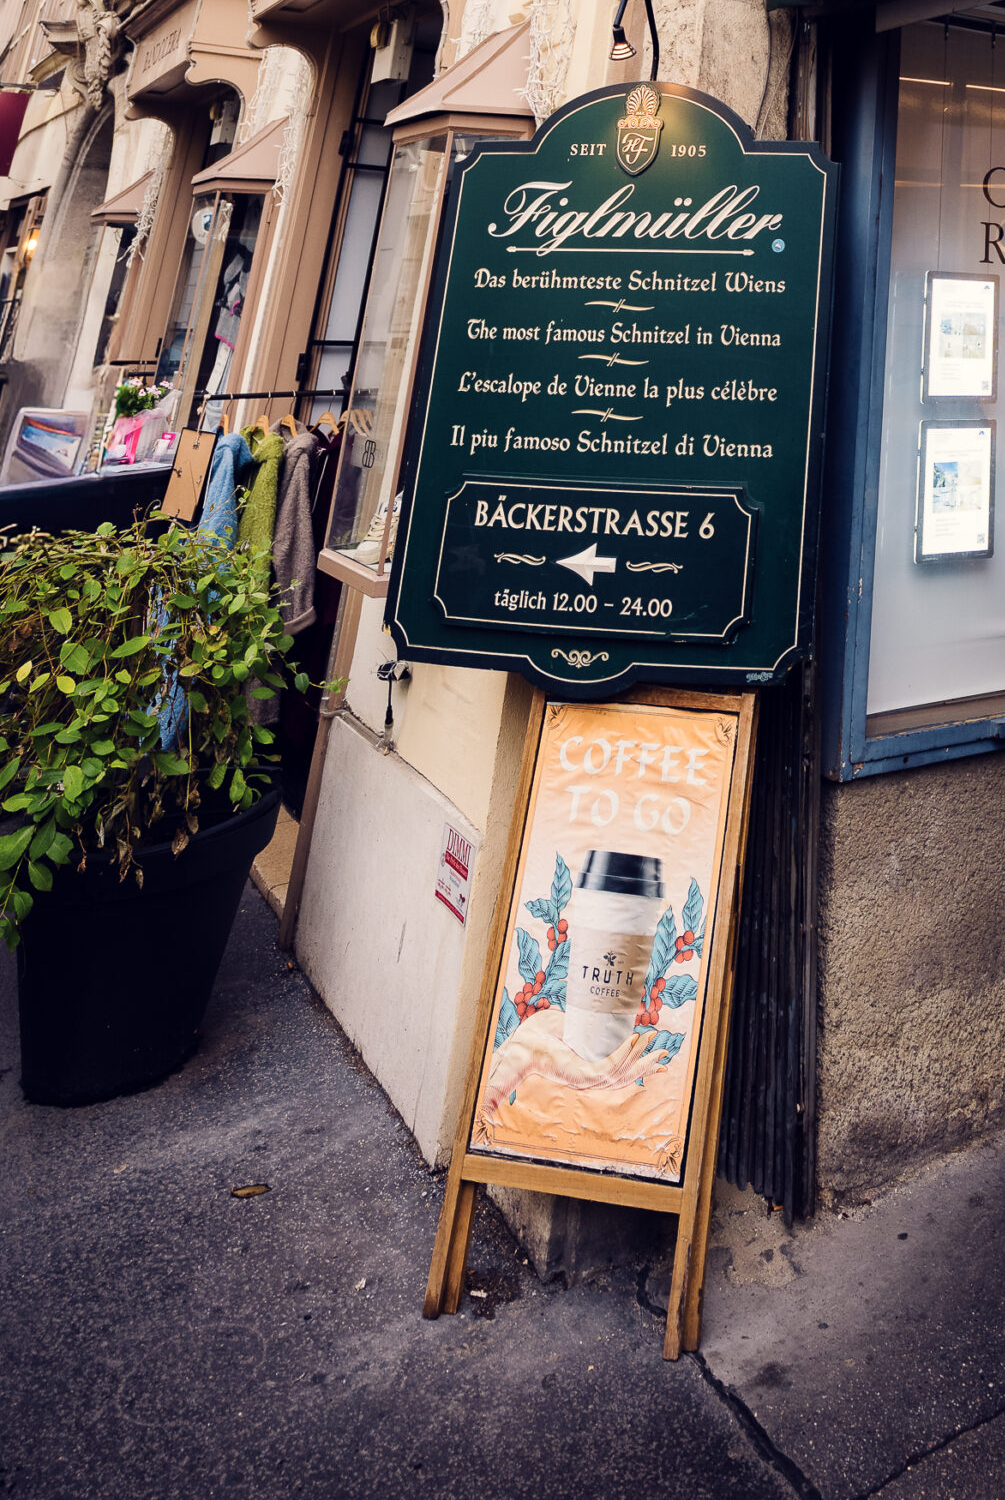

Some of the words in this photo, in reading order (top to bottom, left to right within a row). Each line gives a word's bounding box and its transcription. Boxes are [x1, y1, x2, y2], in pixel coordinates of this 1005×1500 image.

[570, 143, 607, 156] SEIT
[671, 144, 707, 157] 1905
[488, 181, 782, 256] Figlmüller
[474, 268, 507, 289] Das
[513, 270, 622, 291] berühmteste
[628, 270, 717, 293] Schnitzel
[725, 273, 786, 294] Wiens
[467, 320, 498, 341] The
[502, 324, 541, 342] most
[545, 320, 605, 345] famous
[610, 322, 691, 346] Schnitzel
[697, 327, 714, 345] in
[720, 327, 781, 347] Vienna
[458, 371, 542, 402] L'escalope
[547, 377, 568, 396] de
[574, 376, 637, 398] Vienne
[643, 378, 660, 398] la
[666, 379, 705, 406] plus
[711, 378, 778, 402] célèbre
[450, 425, 465, 446] Il
[469, 428, 499, 455] piu
[504, 427, 571, 453] famoso
[576, 431, 668, 456] Schnitzel
[675, 435, 694, 455] di
[703, 435, 774, 458] Vienna
[475, 496, 689, 537] BÄCKERSTRASSE
[699, 511, 716, 540] 6
[494, 589, 546, 613] täglich
[552, 591, 598, 613] 12.00
[619, 596, 674, 618] 24.00
[561, 737, 709, 786] COFFEE
[567, 787, 619, 827] TO
[635, 794, 691, 835] GO
[446, 828, 472, 868] DIMMI
[582, 965, 634, 986] TRUTH
[590, 986, 620, 997] COFFEE
